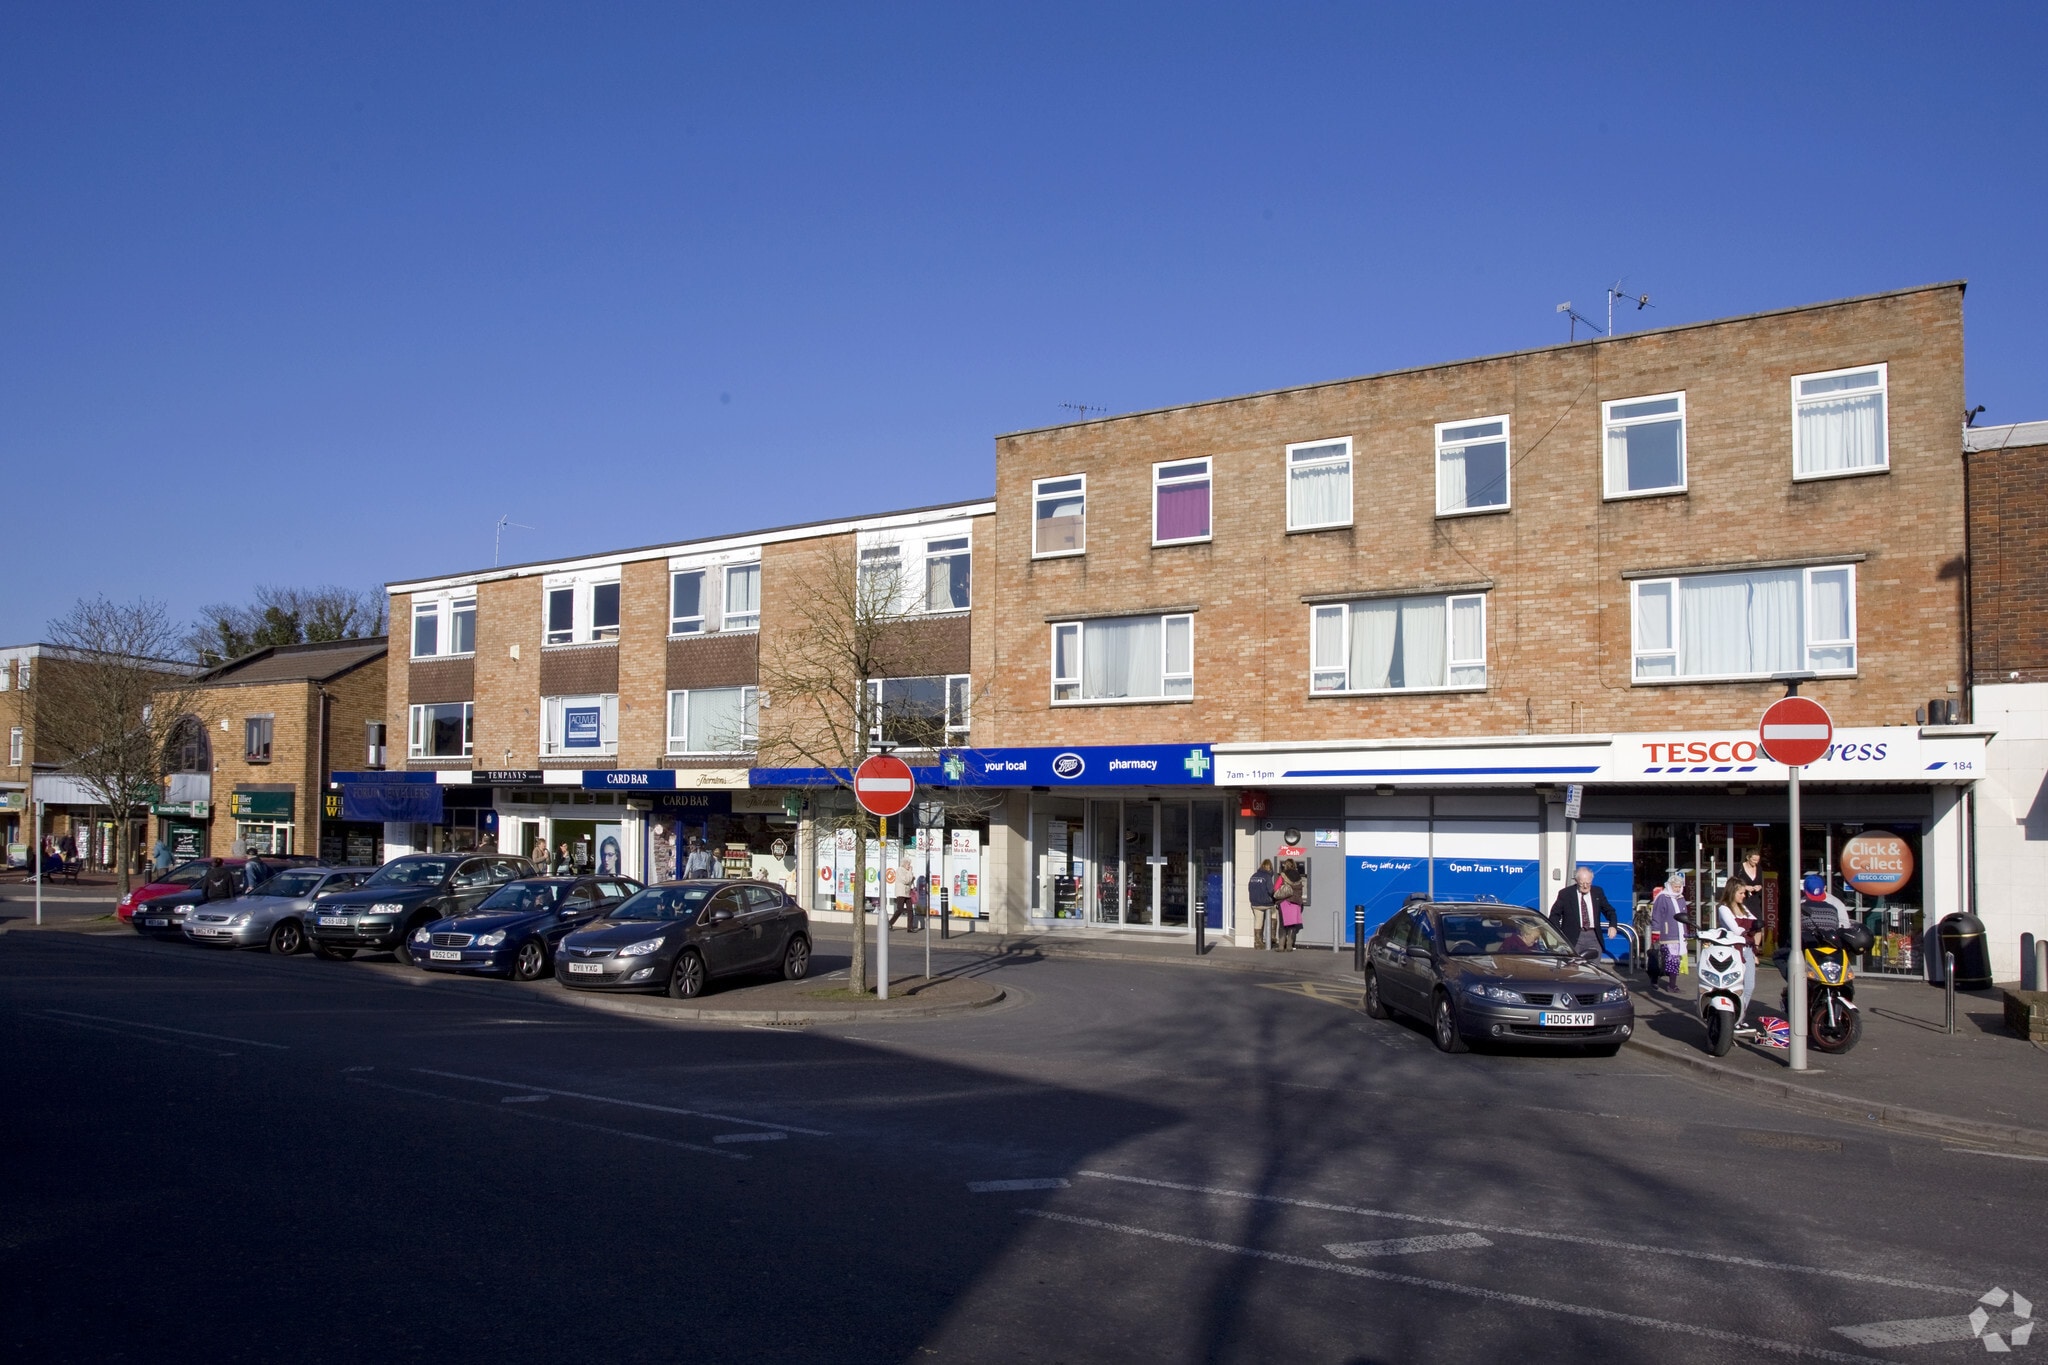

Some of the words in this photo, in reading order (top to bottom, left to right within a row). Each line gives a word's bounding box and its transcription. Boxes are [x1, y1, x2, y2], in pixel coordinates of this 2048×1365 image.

[571, 715, 596, 725] ACUVUE
[1642, 741, 1757, 763] TESCO
[985, 761, 1003, 773] your
[1005, 760, 1027, 771] local
[1056, 758, 1078, 774] Boots
[1109, 759, 1158, 772] pharmacy
[1952, 761, 1973, 771] 184
[488, 771, 527, 780] TEMPANYS
[606, 773, 630, 785] CARD
[631, 773, 649, 785] BAR
[696, 773, 727, 787] Thorntons
[1226, 770, 1244, 779] 7am
[1252, 770, 1275, 780] 11pm
[662, 794, 689, 807] CARD
[690, 794, 709, 807] BAR
[1252, 799, 1265, 811] Cash
[919, 837, 923, 846] 3
[953, 839, 959, 848] 3
[964, 839, 970, 848] 2
[1285, 849, 1300, 857] Cash
[1849, 841, 1887, 856] Click
[1887, 841, 1901, 856] &
[1361, 861, 1378, 872] Every
[1395, 862, 1412, 871] helps
[1450, 863, 1473, 873] Open
[1474, 863, 1492, 873] 7am
[1499, 864, 1523, 875] 11pm
[1857, 873, 1896, 881] tesco.com
[1766, 882, 1776, 913] Special
[1546, 1014, 1572, 1025] HD05
[1574, 1014, 1593, 1025] KVP
